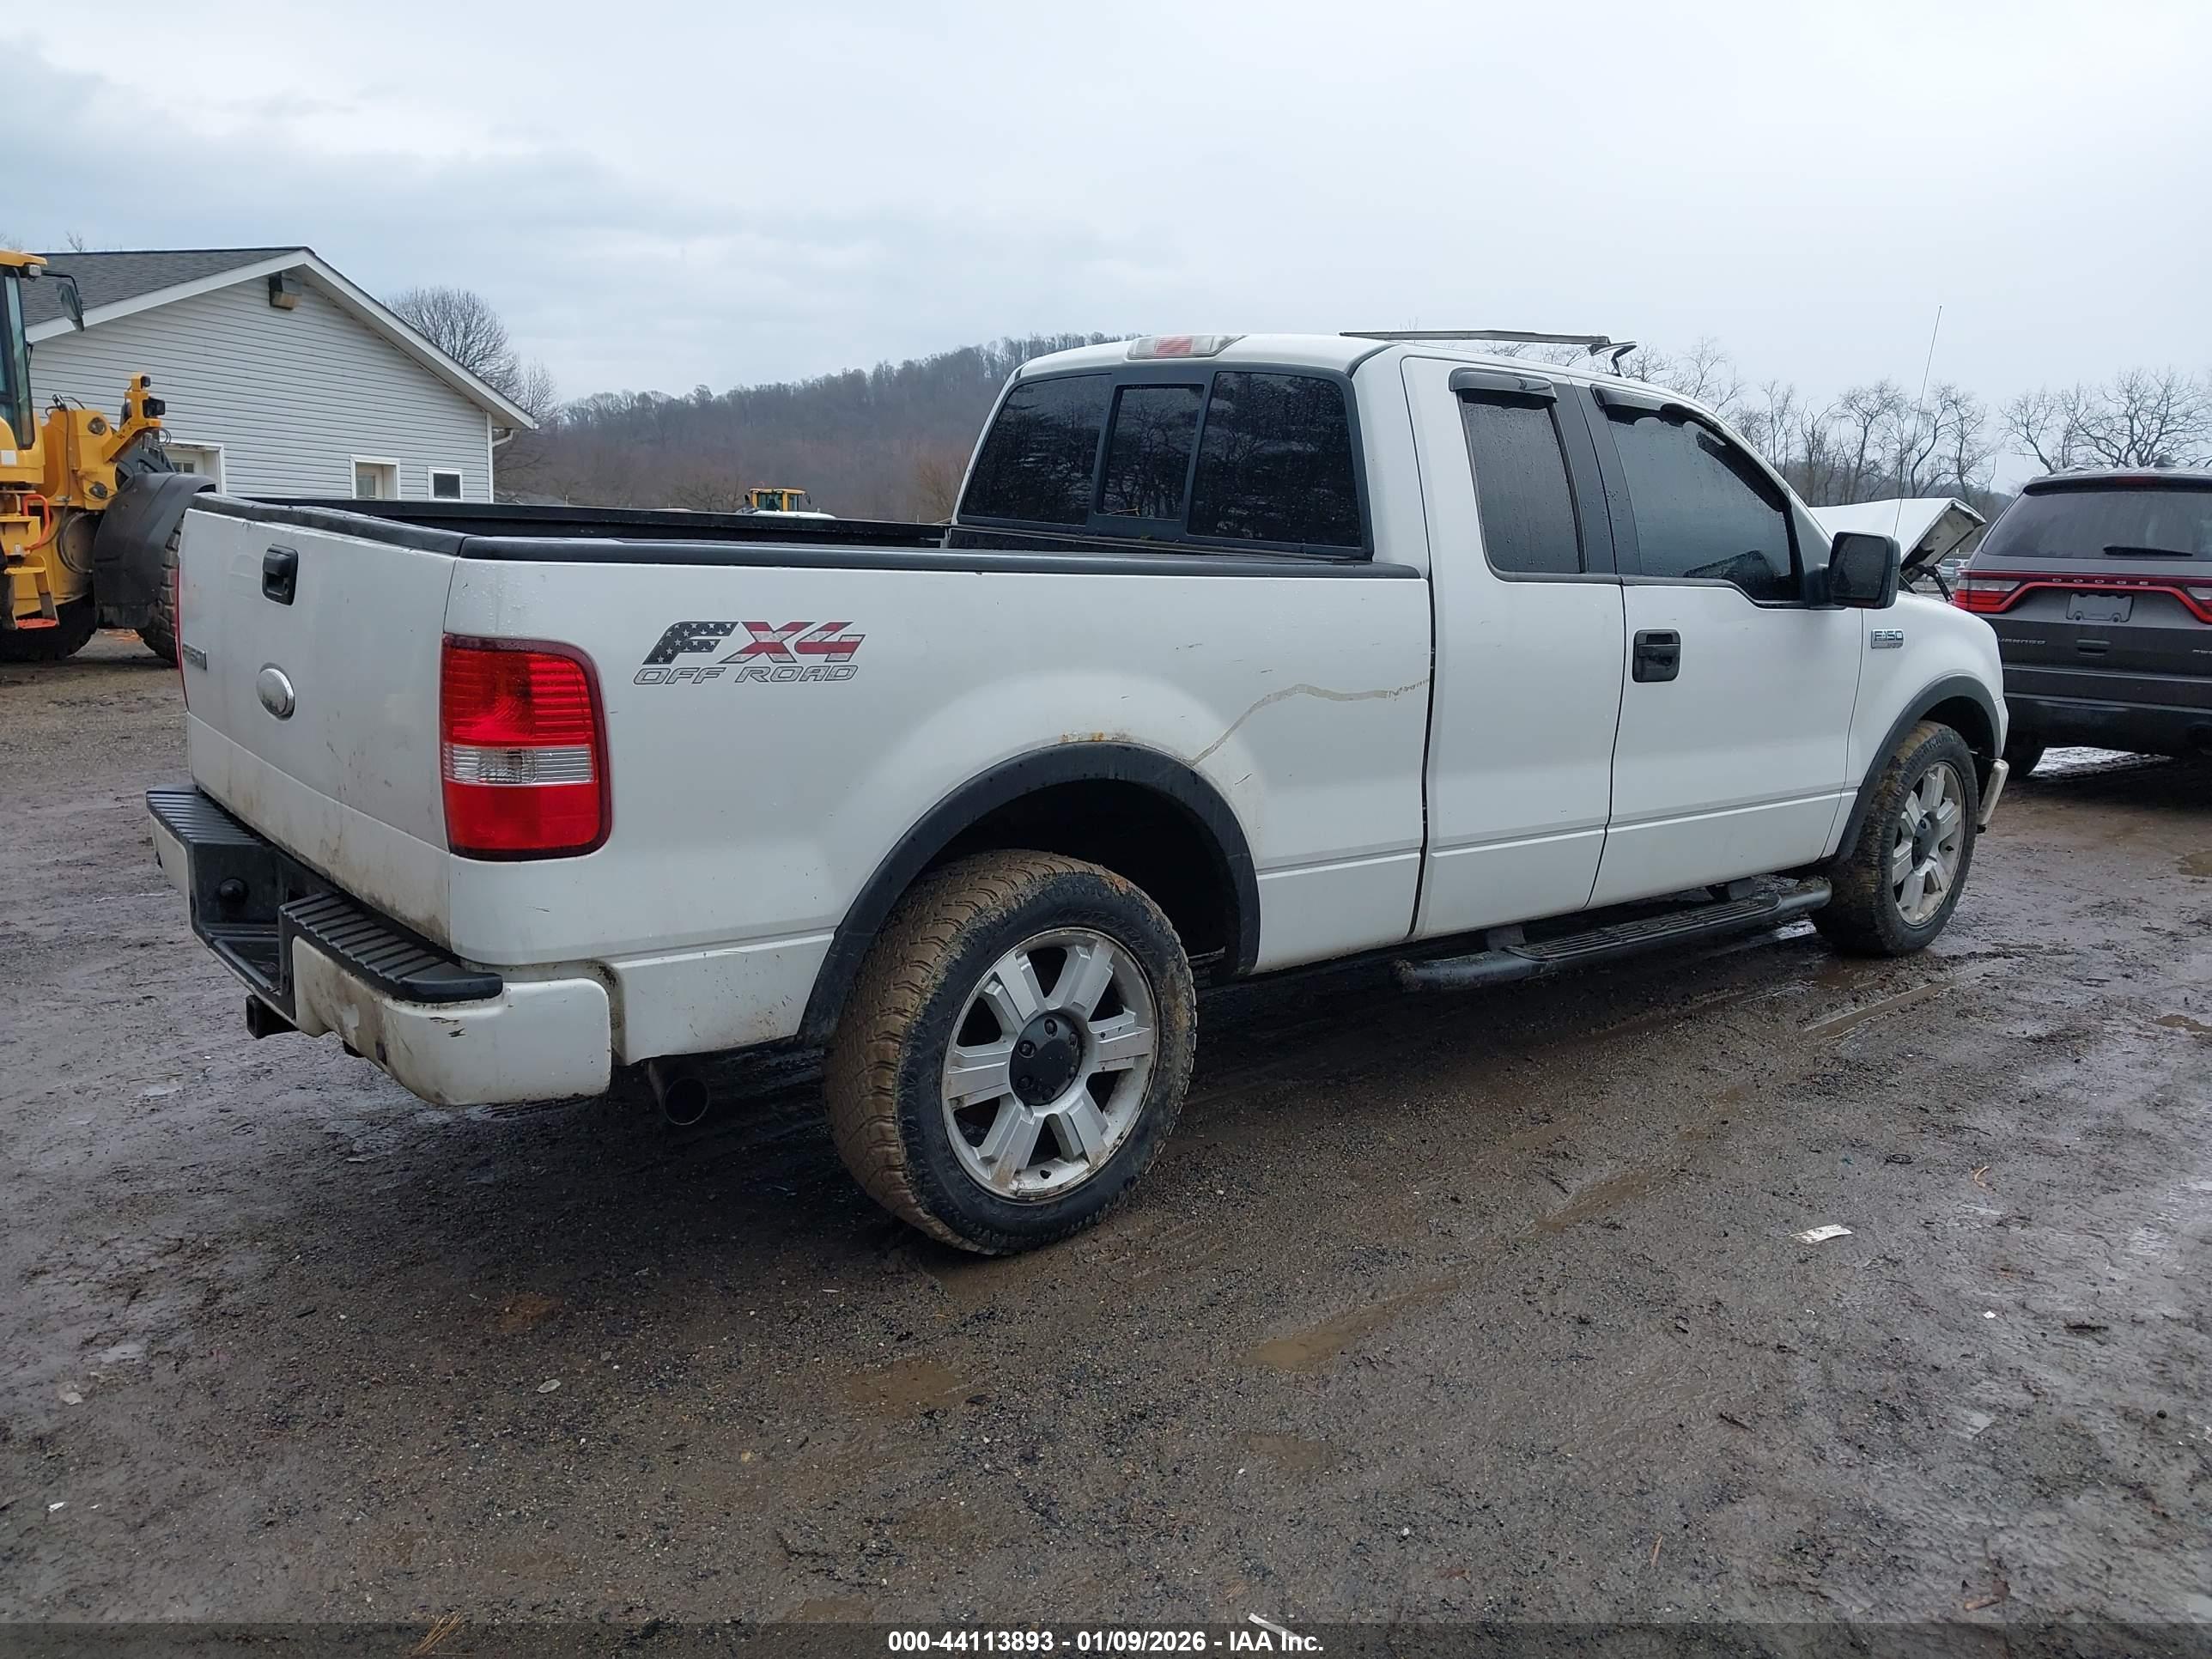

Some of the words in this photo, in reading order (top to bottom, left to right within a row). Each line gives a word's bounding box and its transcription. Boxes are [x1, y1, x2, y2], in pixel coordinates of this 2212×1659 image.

[641, 621, 866, 665] FX4
[633, 666, 727, 685] OFF
[735, 665, 859, 684] ROAD
